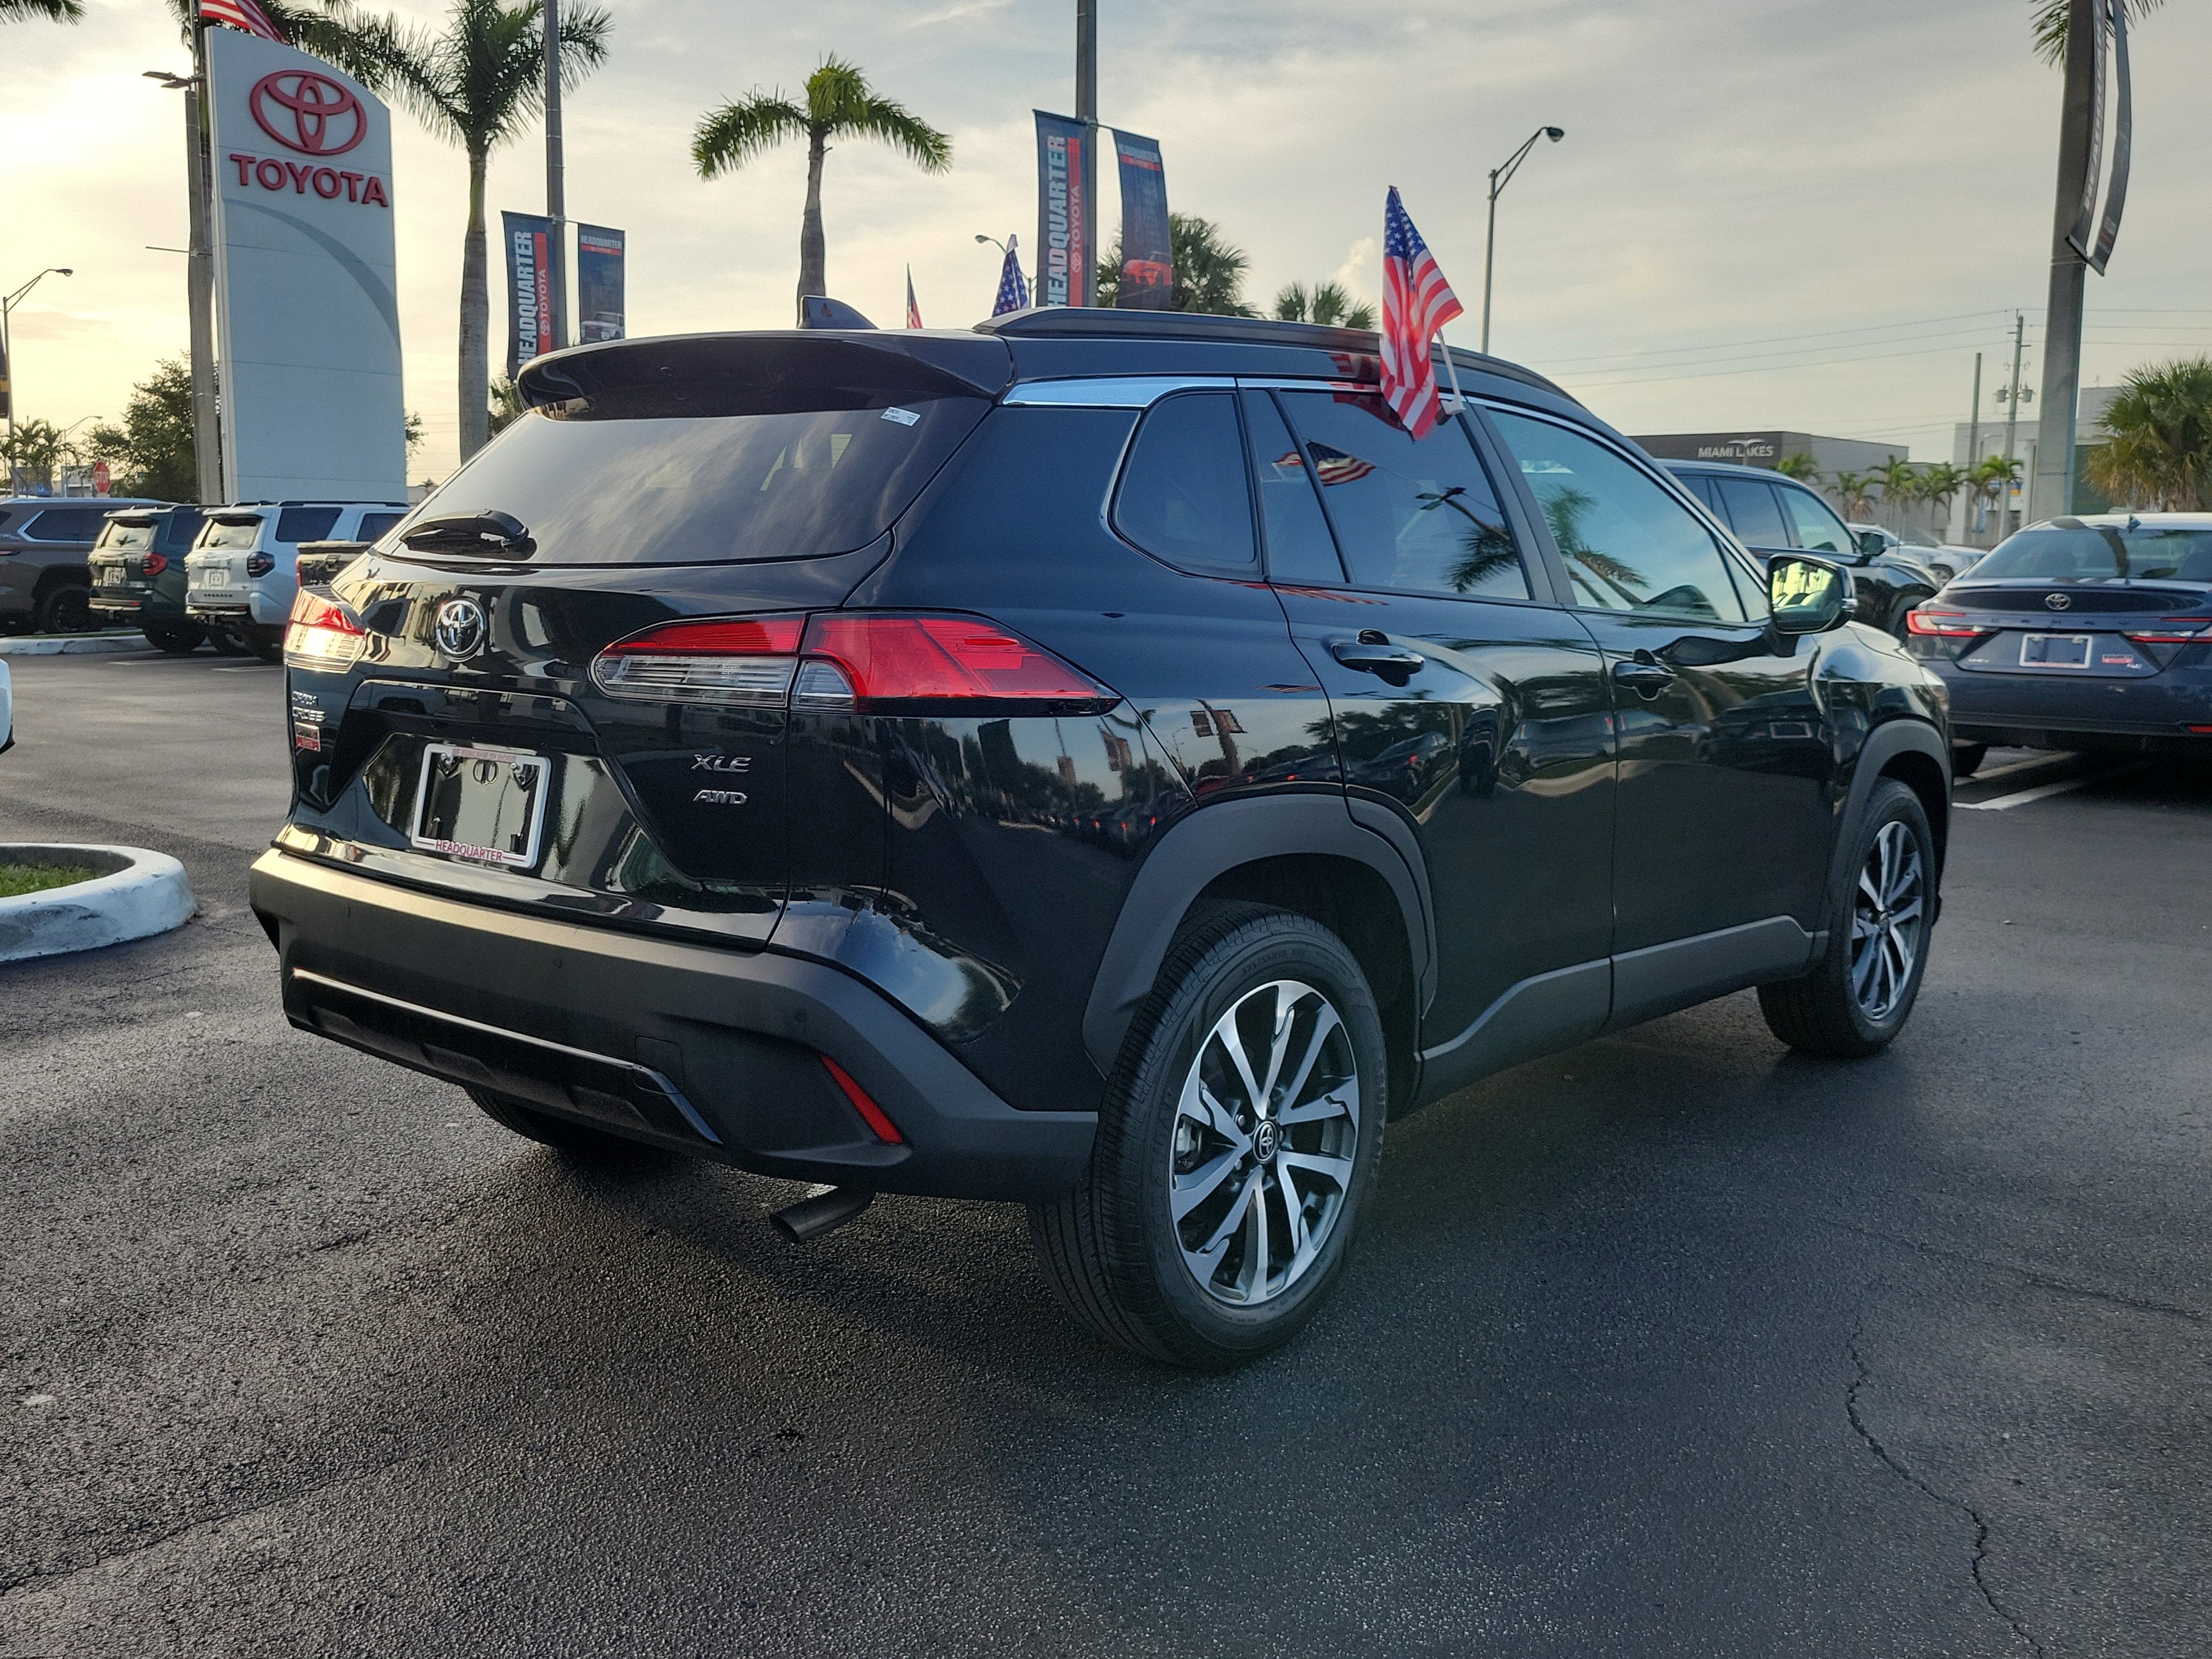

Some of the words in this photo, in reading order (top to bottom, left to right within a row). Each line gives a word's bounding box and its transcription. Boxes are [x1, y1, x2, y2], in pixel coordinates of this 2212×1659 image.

[230, 154, 389, 207] TOYOTA
[1047, 136, 1070, 307] HEADQUARTER
[1071, 185, 1081, 250] TOYOTA
[514, 231, 538, 364] HEADQUARTER
[537, 269, 549, 319] TOYOTA
[1698, 447, 1733, 458] MIAMI
[1736, 445, 1774, 456] LAKES
[95, 471, 109, 483] STOP
[691, 754, 752, 773] XLE
[693, 789, 747, 804] AWD
[435, 840, 503, 861] HEADQUARTER
